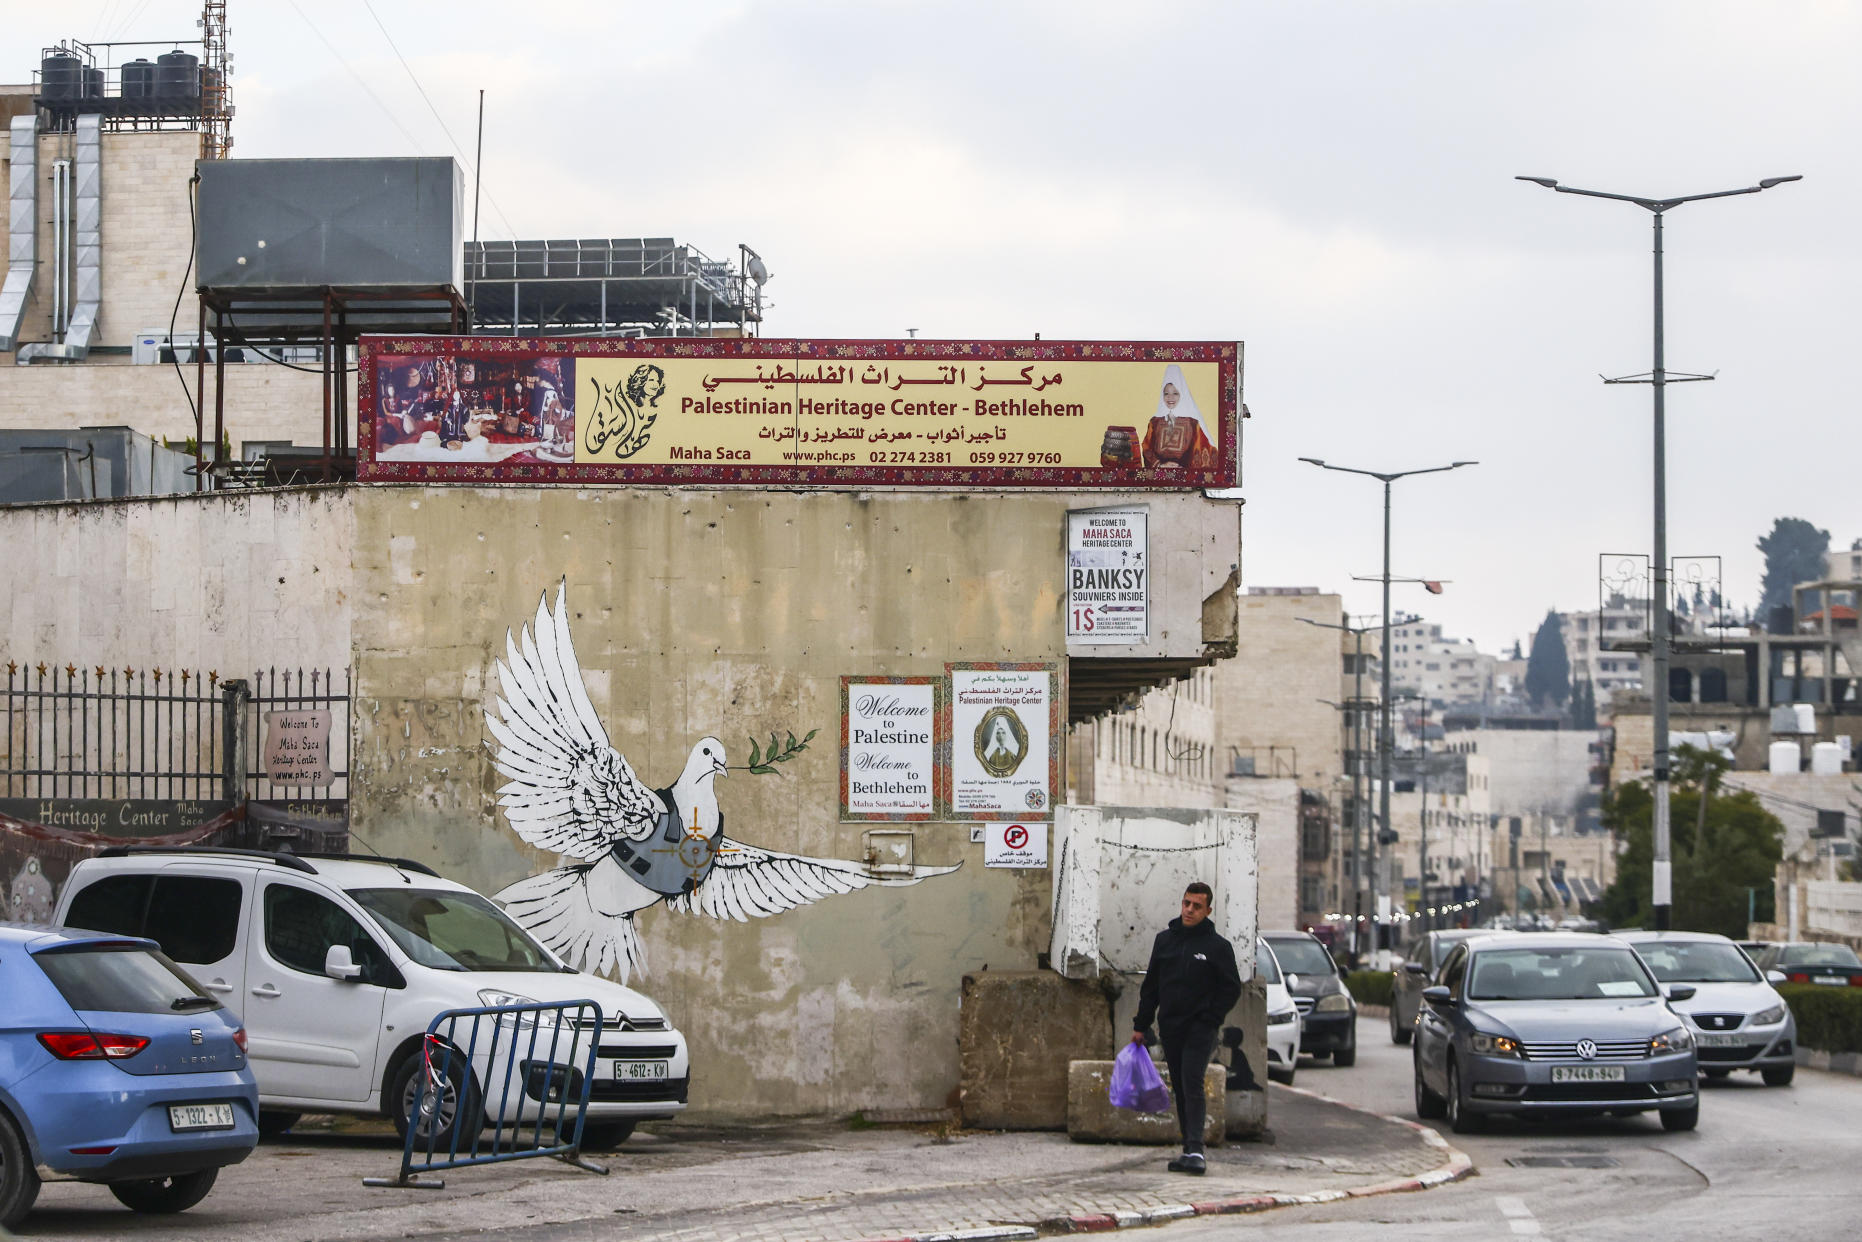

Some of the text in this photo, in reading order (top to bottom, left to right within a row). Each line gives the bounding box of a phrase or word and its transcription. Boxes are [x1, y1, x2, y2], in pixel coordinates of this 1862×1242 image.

[702, 364, 1063, 392] مركز التراث الفلسطيني
[681, 397, 792, 415] Palestinian
[798, 398, 886, 419] Heritage
[890, 399, 957, 416] Center
[974, 399, 1084, 417] Bethlehem
[758, 426, 810, 442] والتراث
[810, 426, 865, 443] للتطريز
[868, 428, 912, 443] معرض
[669, 446, 751, 460] Maha Saca
[782, 450, 856, 463] www.phc.ps
[869, 452, 951, 463] 02 274 2381
[969, 452, 1062, 464] 059 927 9760
[1089, 518, 1127, 527] WELCOME TO
[1082, 528, 1132, 539] MAHA SACA
[1082, 539, 1133, 548] HERITAGE CENTER
[1072, 568, 1145, 590] BANKSY
[1072, 591, 1144, 602] SOUVNIERS INSIDE
[1073, 607, 1095, 632] 1$
[1002, 687, 1024, 695] التراث
[1024, 687, 1043, 696] مركز
[855, 693, 930, 720] Welcome
[958, 696, 1042, 707] Palestinian Heritage Center
[279, 716, 320, 729] Welcome To
[883, 719, 895, 729] to
[279, 736, 320, 750] Maha Saca
[853, 729, 929, 744] Palestine
[272, 753, 318, 767] Heritage Center
[854, 751, 912, 772] Welcome
[906, 771, 919, 781] to
[852, 781, 928, 794] Bethlehem
[853, 800, 874, 808] Maha
[39, 801, 169, 833] Heritage Center
[181, 1055, 216, 1063] LEON
